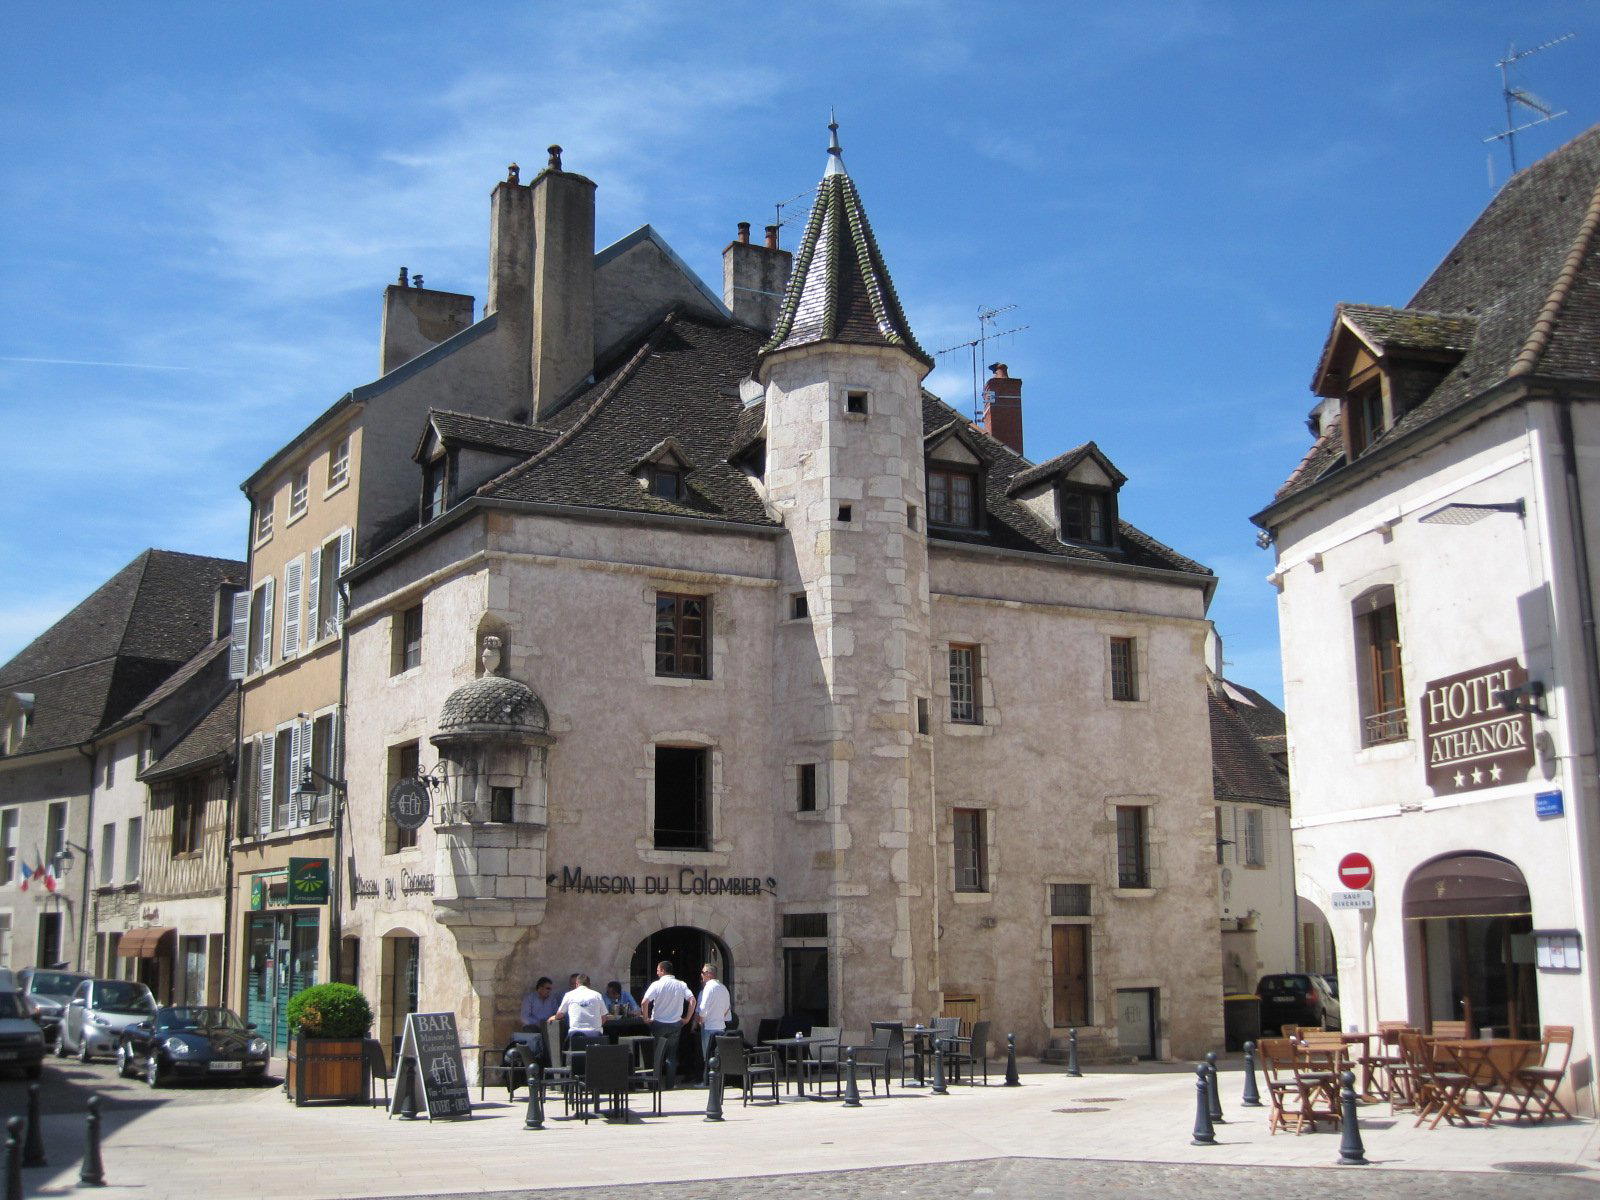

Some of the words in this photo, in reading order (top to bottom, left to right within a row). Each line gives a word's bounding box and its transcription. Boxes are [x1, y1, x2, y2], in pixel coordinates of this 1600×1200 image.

[1427, 669, 1512, 725] HOTEL
[1431, 720, 1526, 763] ATHANOR
[417, 1015, 452, 1031] BAR
